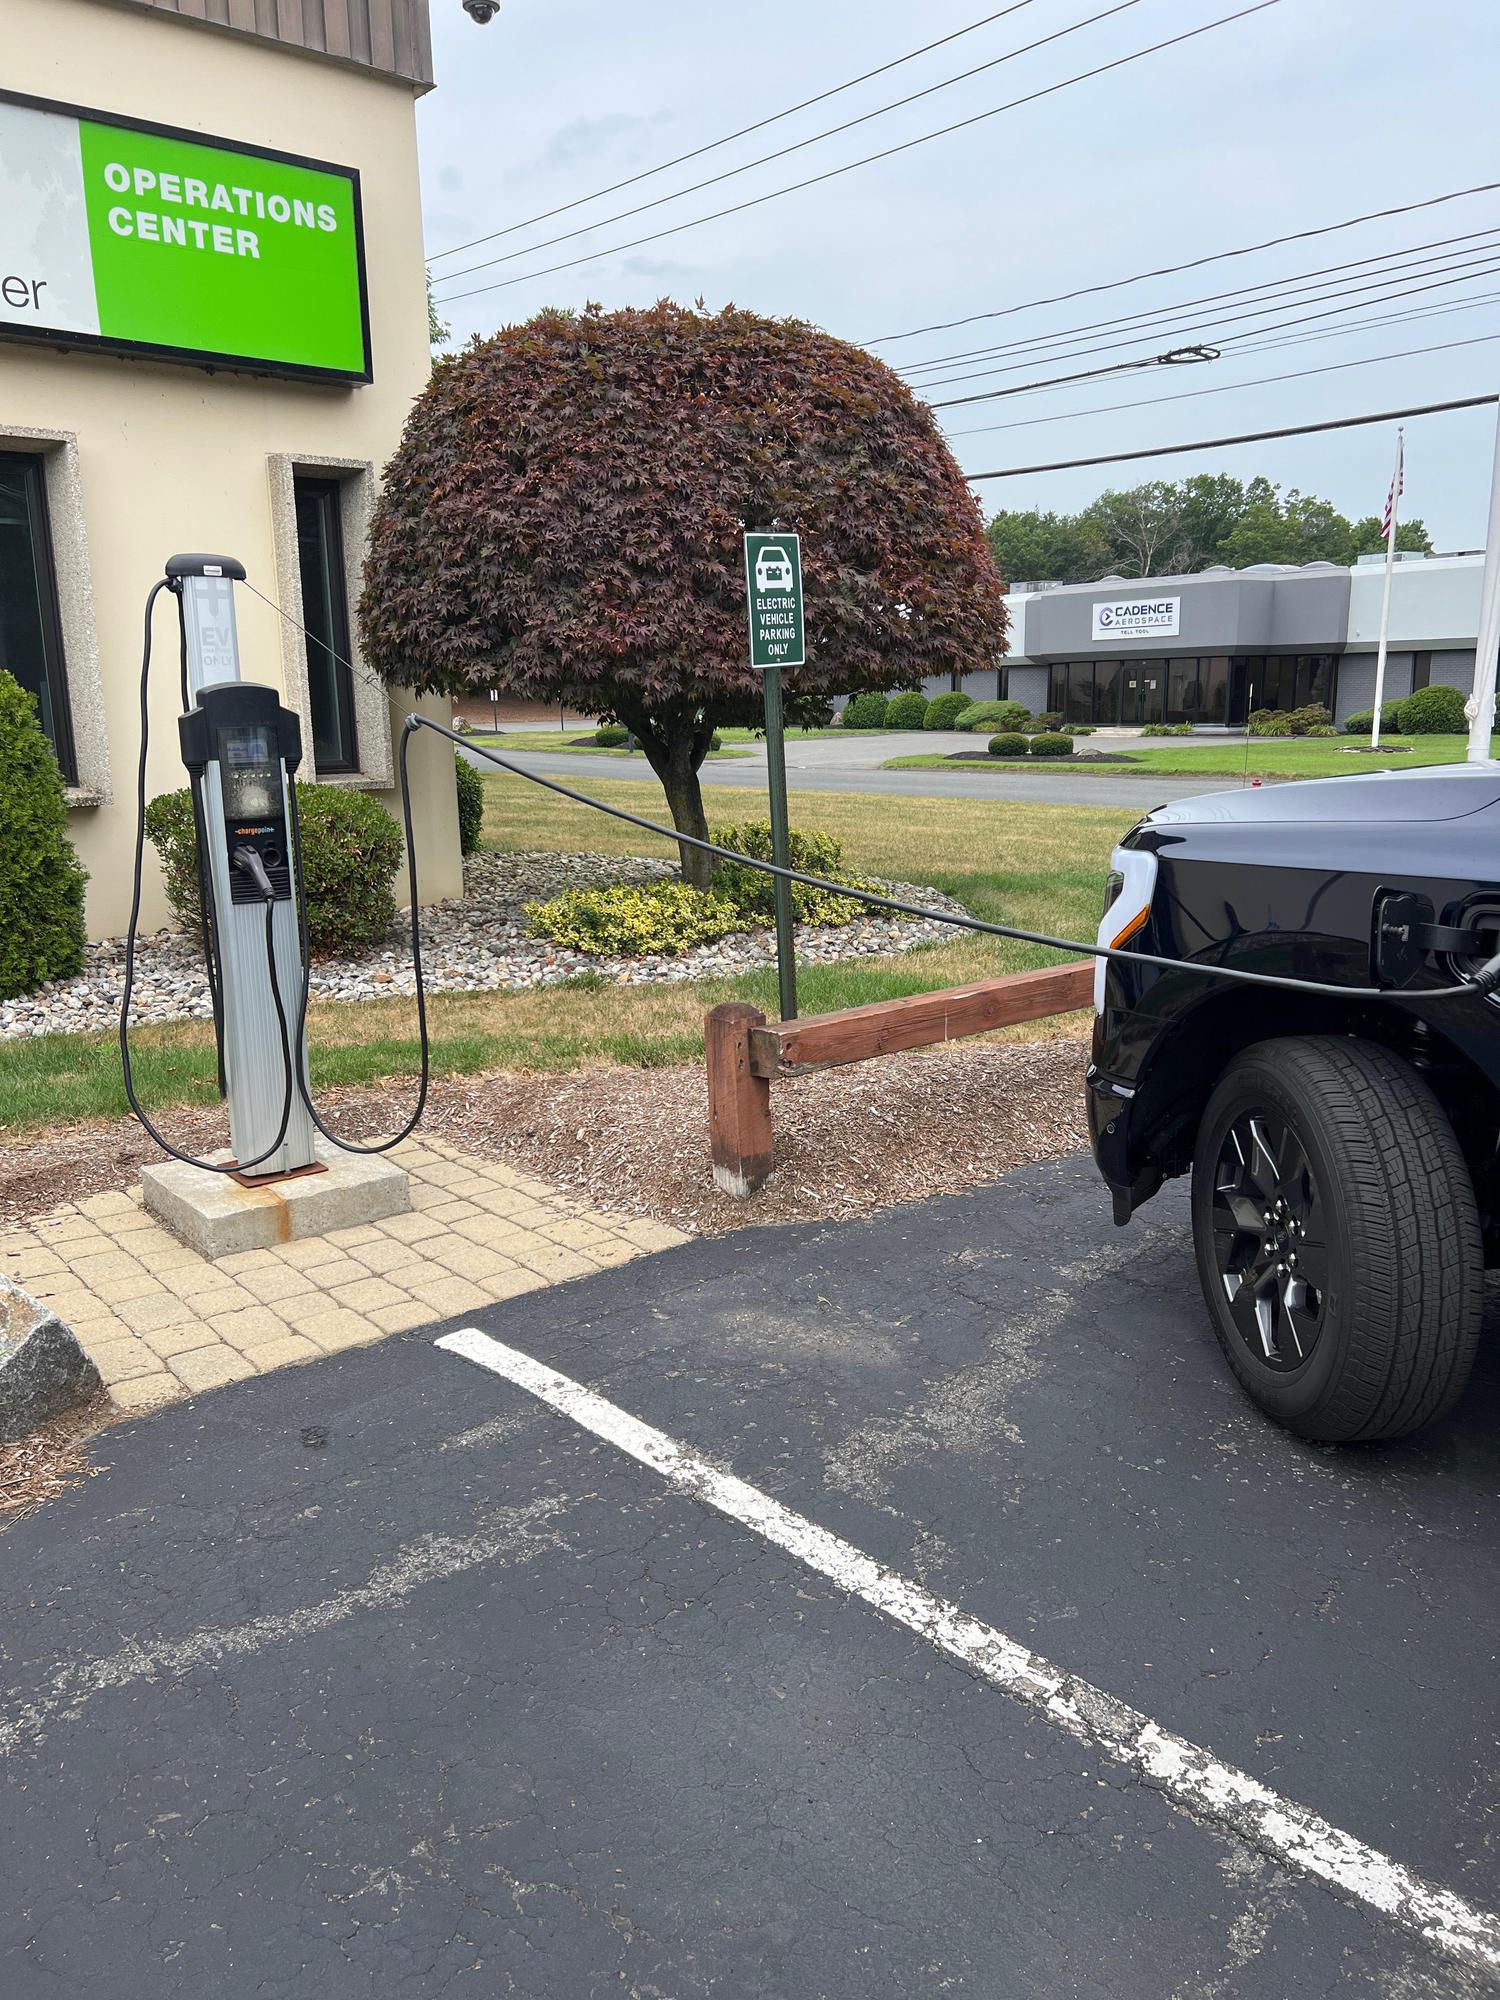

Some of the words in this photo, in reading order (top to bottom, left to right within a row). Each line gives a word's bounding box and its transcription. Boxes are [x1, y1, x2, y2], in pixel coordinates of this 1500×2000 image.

[104, 163, 337, 232] OPERATIONS
[108, 207, 260, 259] CENTER
[757, 597, 796, 610] ELECTRIC
[1116, 603, 1173, 616] CADENCE
[760, 612, 794, 625] VEHICLE
[1115, 615, 1173, 626] AEROSPACE
[201, 627, 229, 646] EV
[760, 628, 795, 640] PARKING
[768, 643, 789, 656] ONLY
